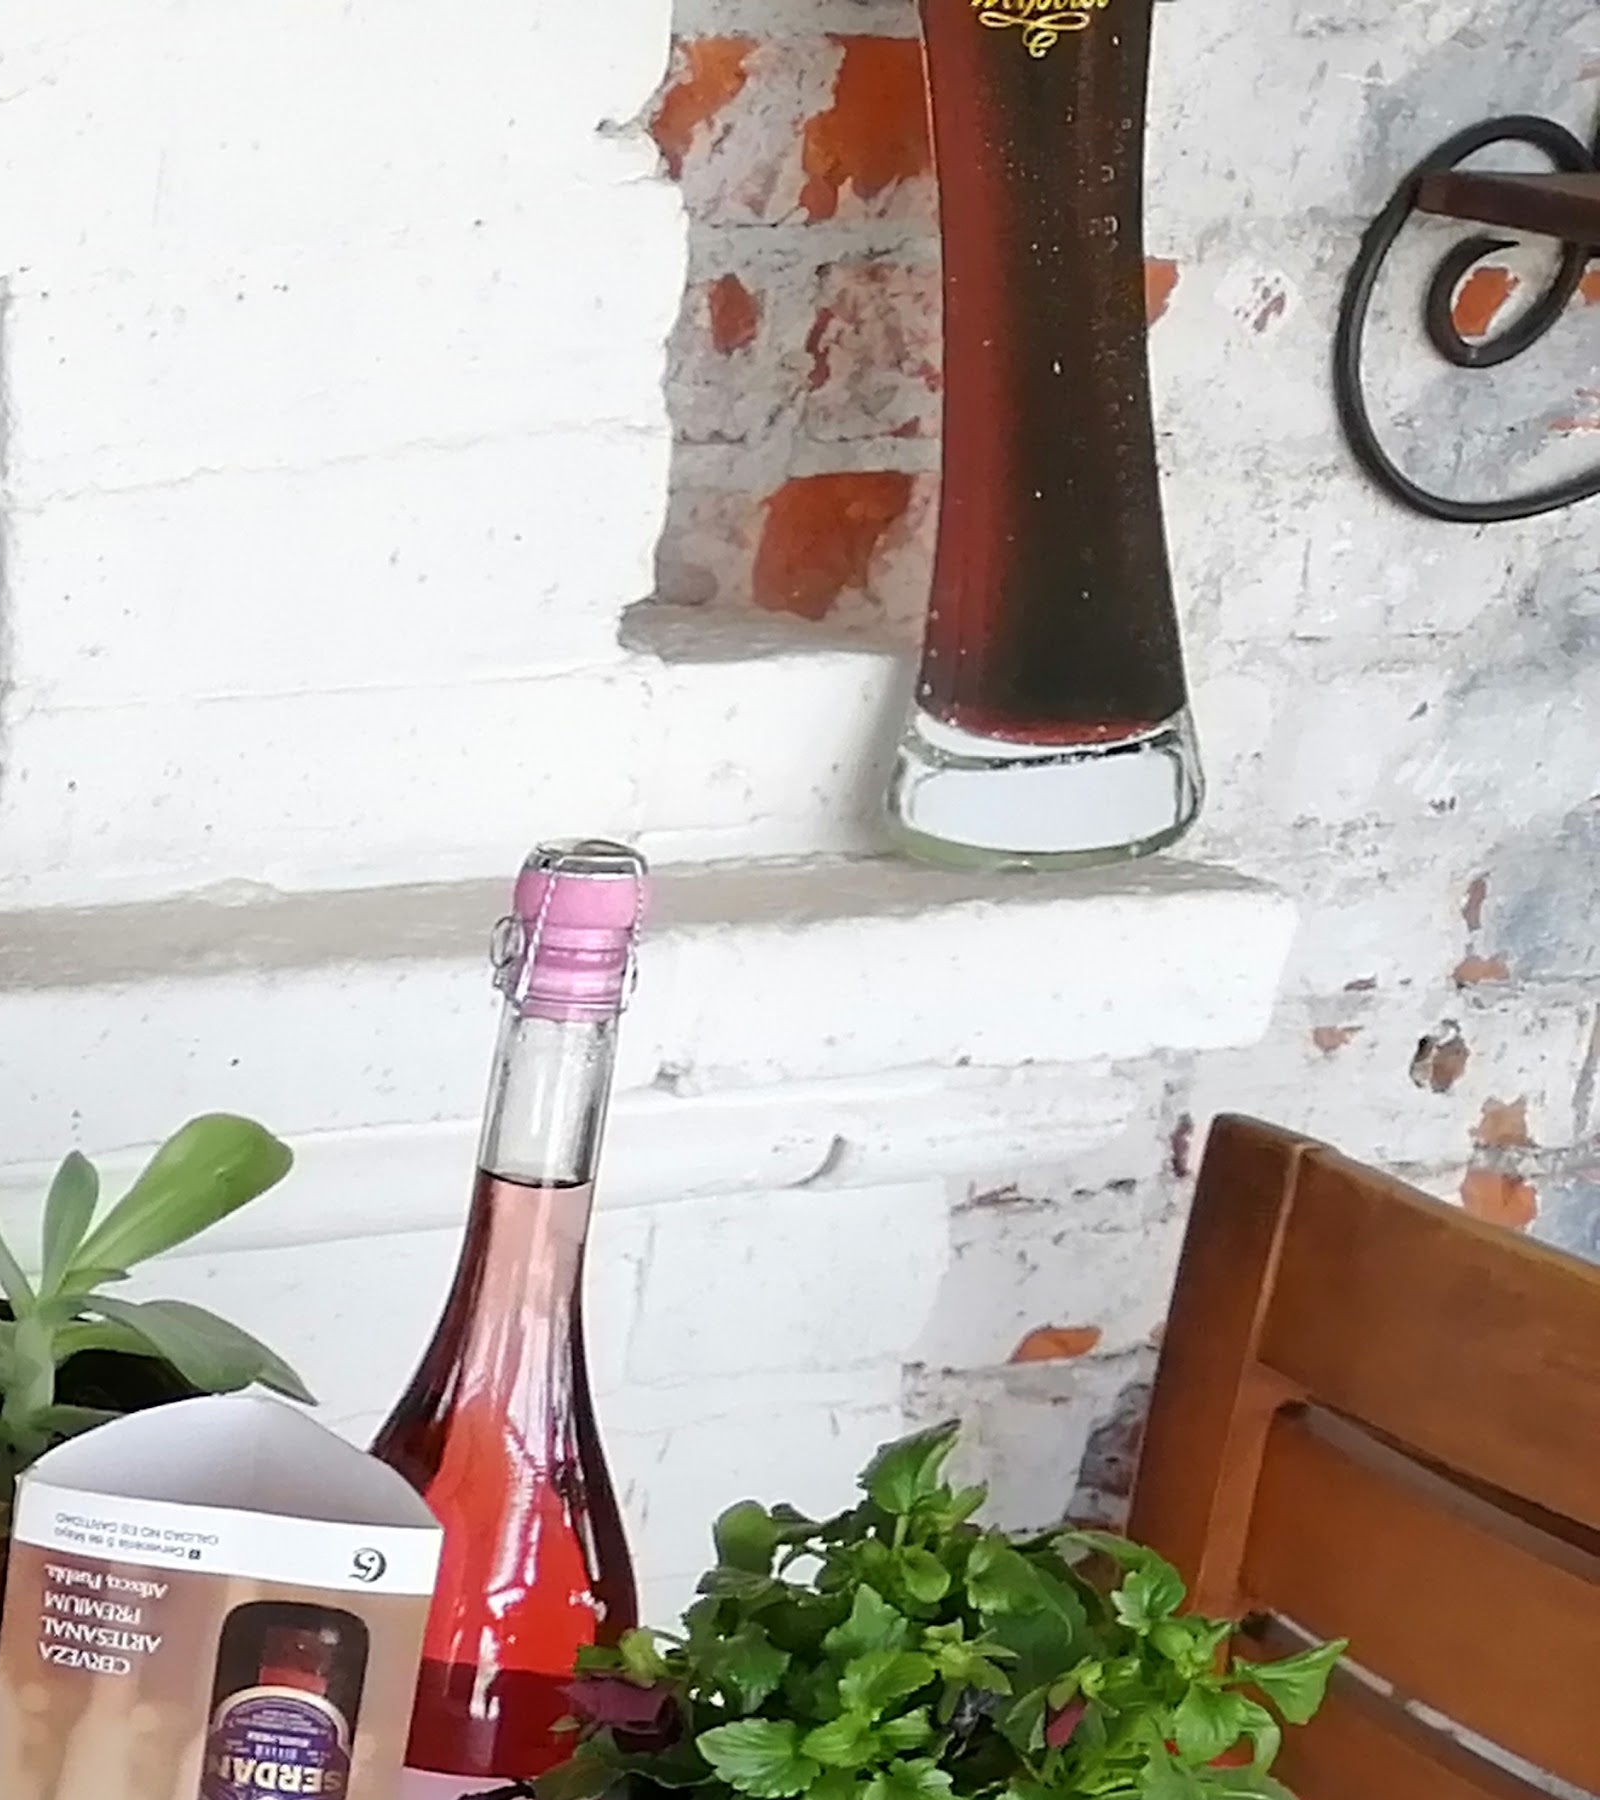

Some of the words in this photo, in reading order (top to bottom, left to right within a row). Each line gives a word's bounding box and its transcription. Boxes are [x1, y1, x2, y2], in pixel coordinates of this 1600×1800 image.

[44, 1590, 142, 1625] PREMIUM
[40, 1615, 162, 1653] ARTESANAL
[38, 1641, 131, 1674] CERVEZA
